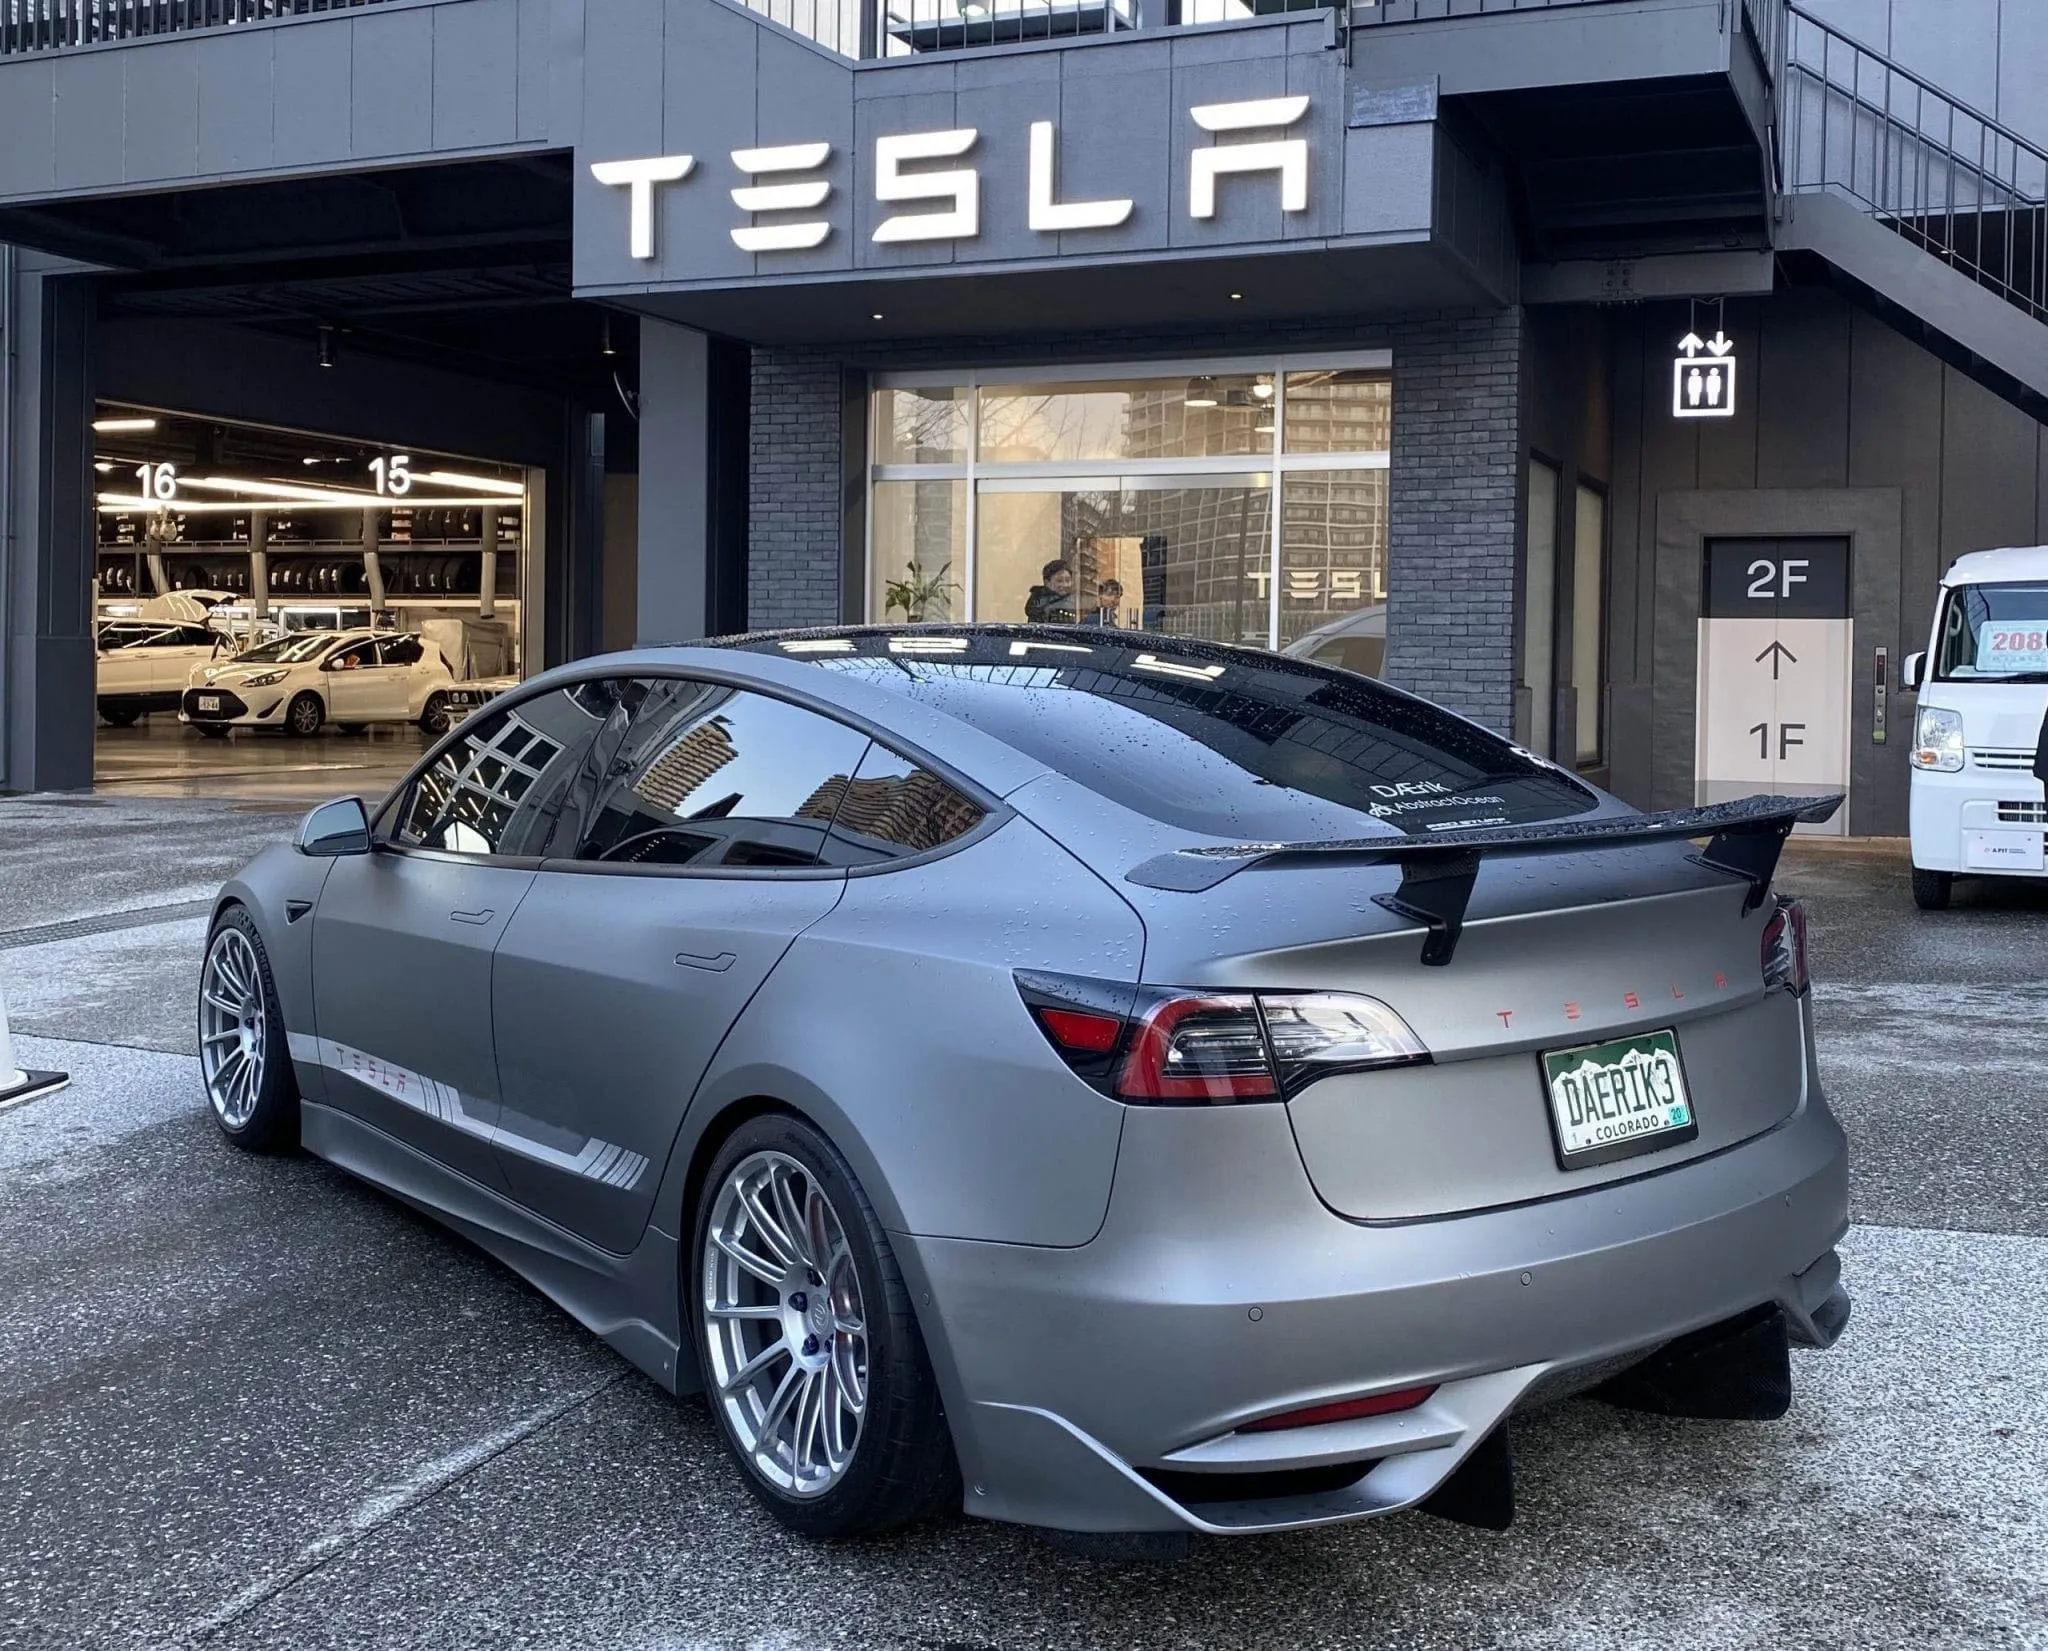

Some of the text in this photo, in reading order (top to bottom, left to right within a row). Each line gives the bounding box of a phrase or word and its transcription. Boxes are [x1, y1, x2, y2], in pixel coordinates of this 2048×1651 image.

[590, 95, 1310, 259] TESLA
[136, 462, 177, 501] 16
[368, 455, 410, 495] 15
[1747, 559, 1809, 598] 2F
[1749, 723, 1806, 760] 1F
[1496, 971, 1729, 1029] TESLA
[335, 1047, 406, 1093] TESLA
[1562, 1058, 1675, 1127] DAERIK3
[1595, 1114, 1659, 1140] COLORADO
